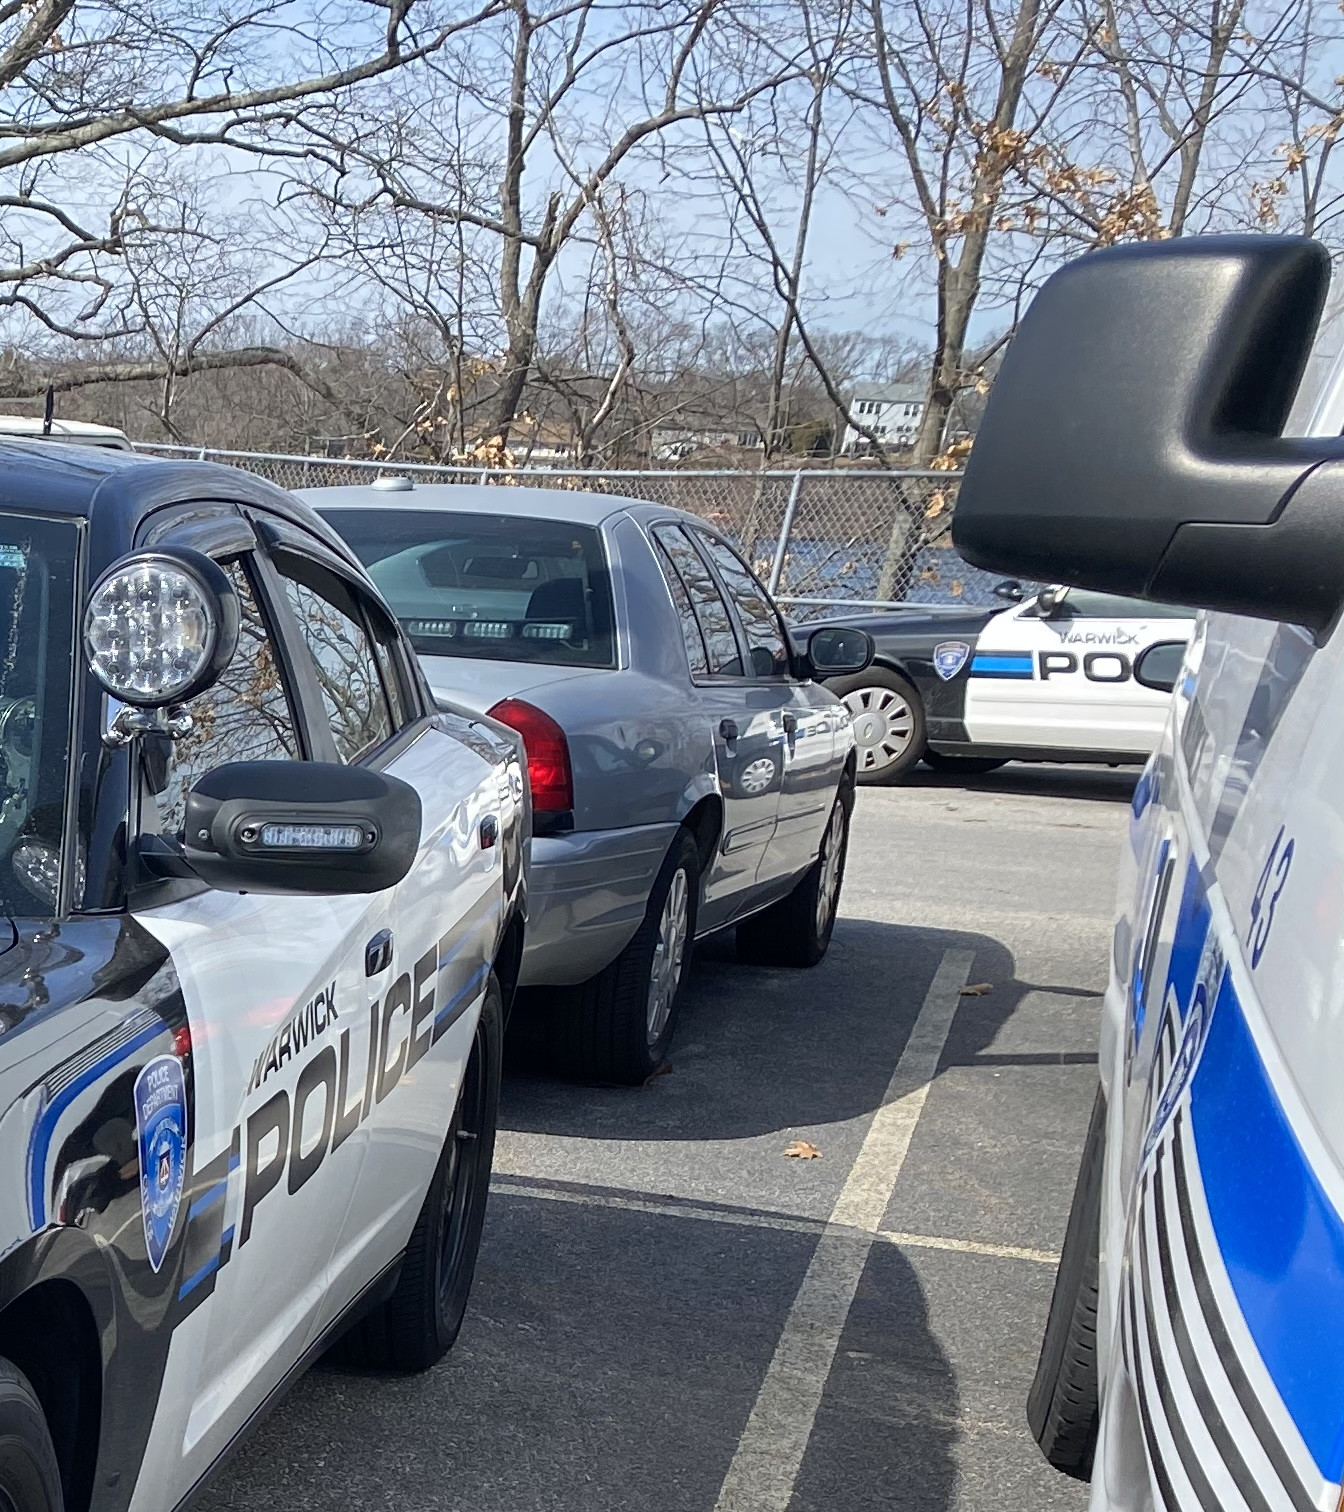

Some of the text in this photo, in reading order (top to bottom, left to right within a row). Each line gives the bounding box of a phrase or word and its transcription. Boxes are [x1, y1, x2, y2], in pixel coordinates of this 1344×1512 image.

[1039, 651, 1139, 682] PO
[247, 980, 340, 1097] WARWICK
[147, 1065, 170, 1093] POLICE
[238, 943, 439, 1250] POLICE
